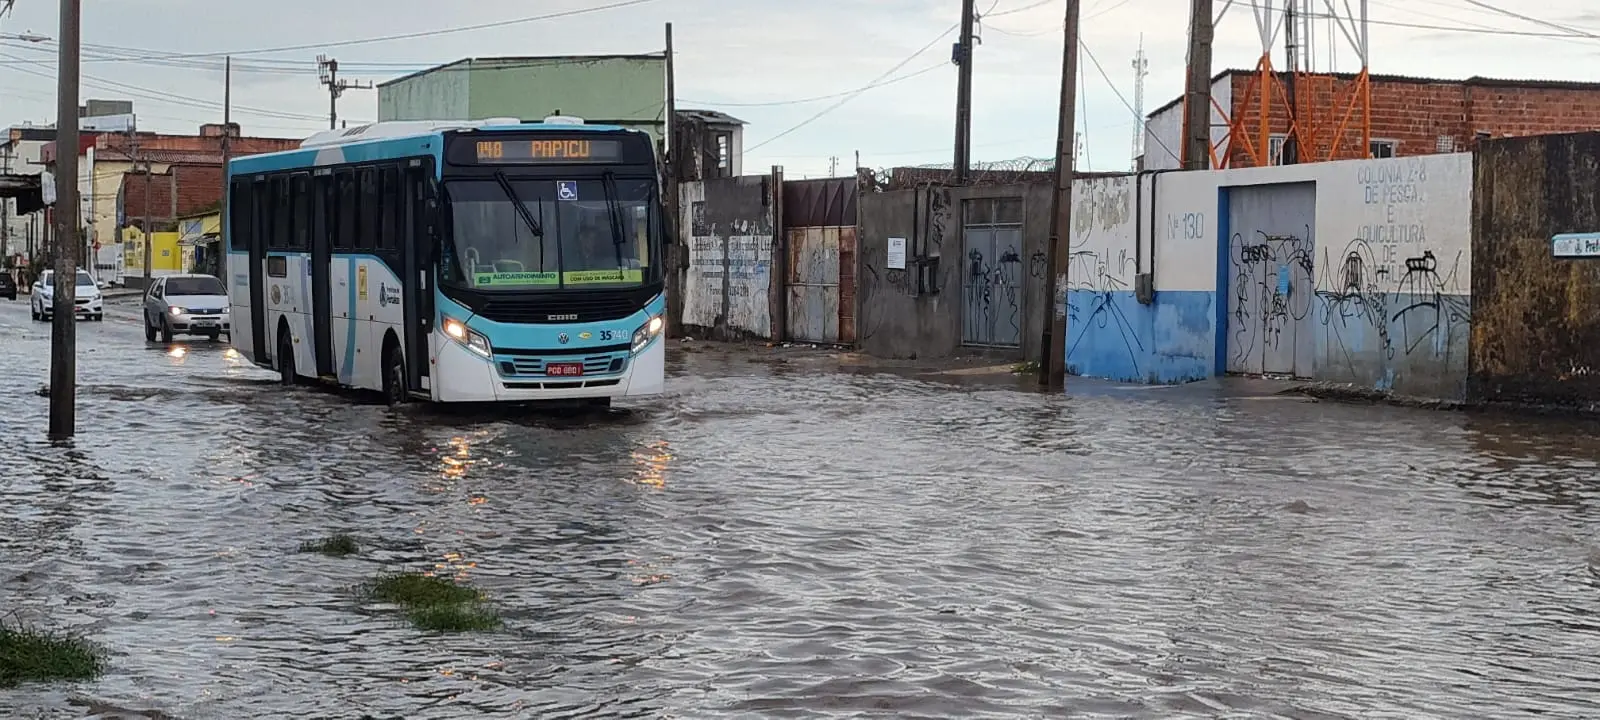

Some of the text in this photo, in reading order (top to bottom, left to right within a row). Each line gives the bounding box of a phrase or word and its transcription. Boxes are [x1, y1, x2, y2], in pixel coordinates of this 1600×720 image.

[532, 140, 590, 158] PAPICU
[1365, 185, 1379, 204] DE
[1387, 204, 1394, 223] E
[1182, 212, 1204, 240] 130
[1383, 244, 1396, 263] DE
